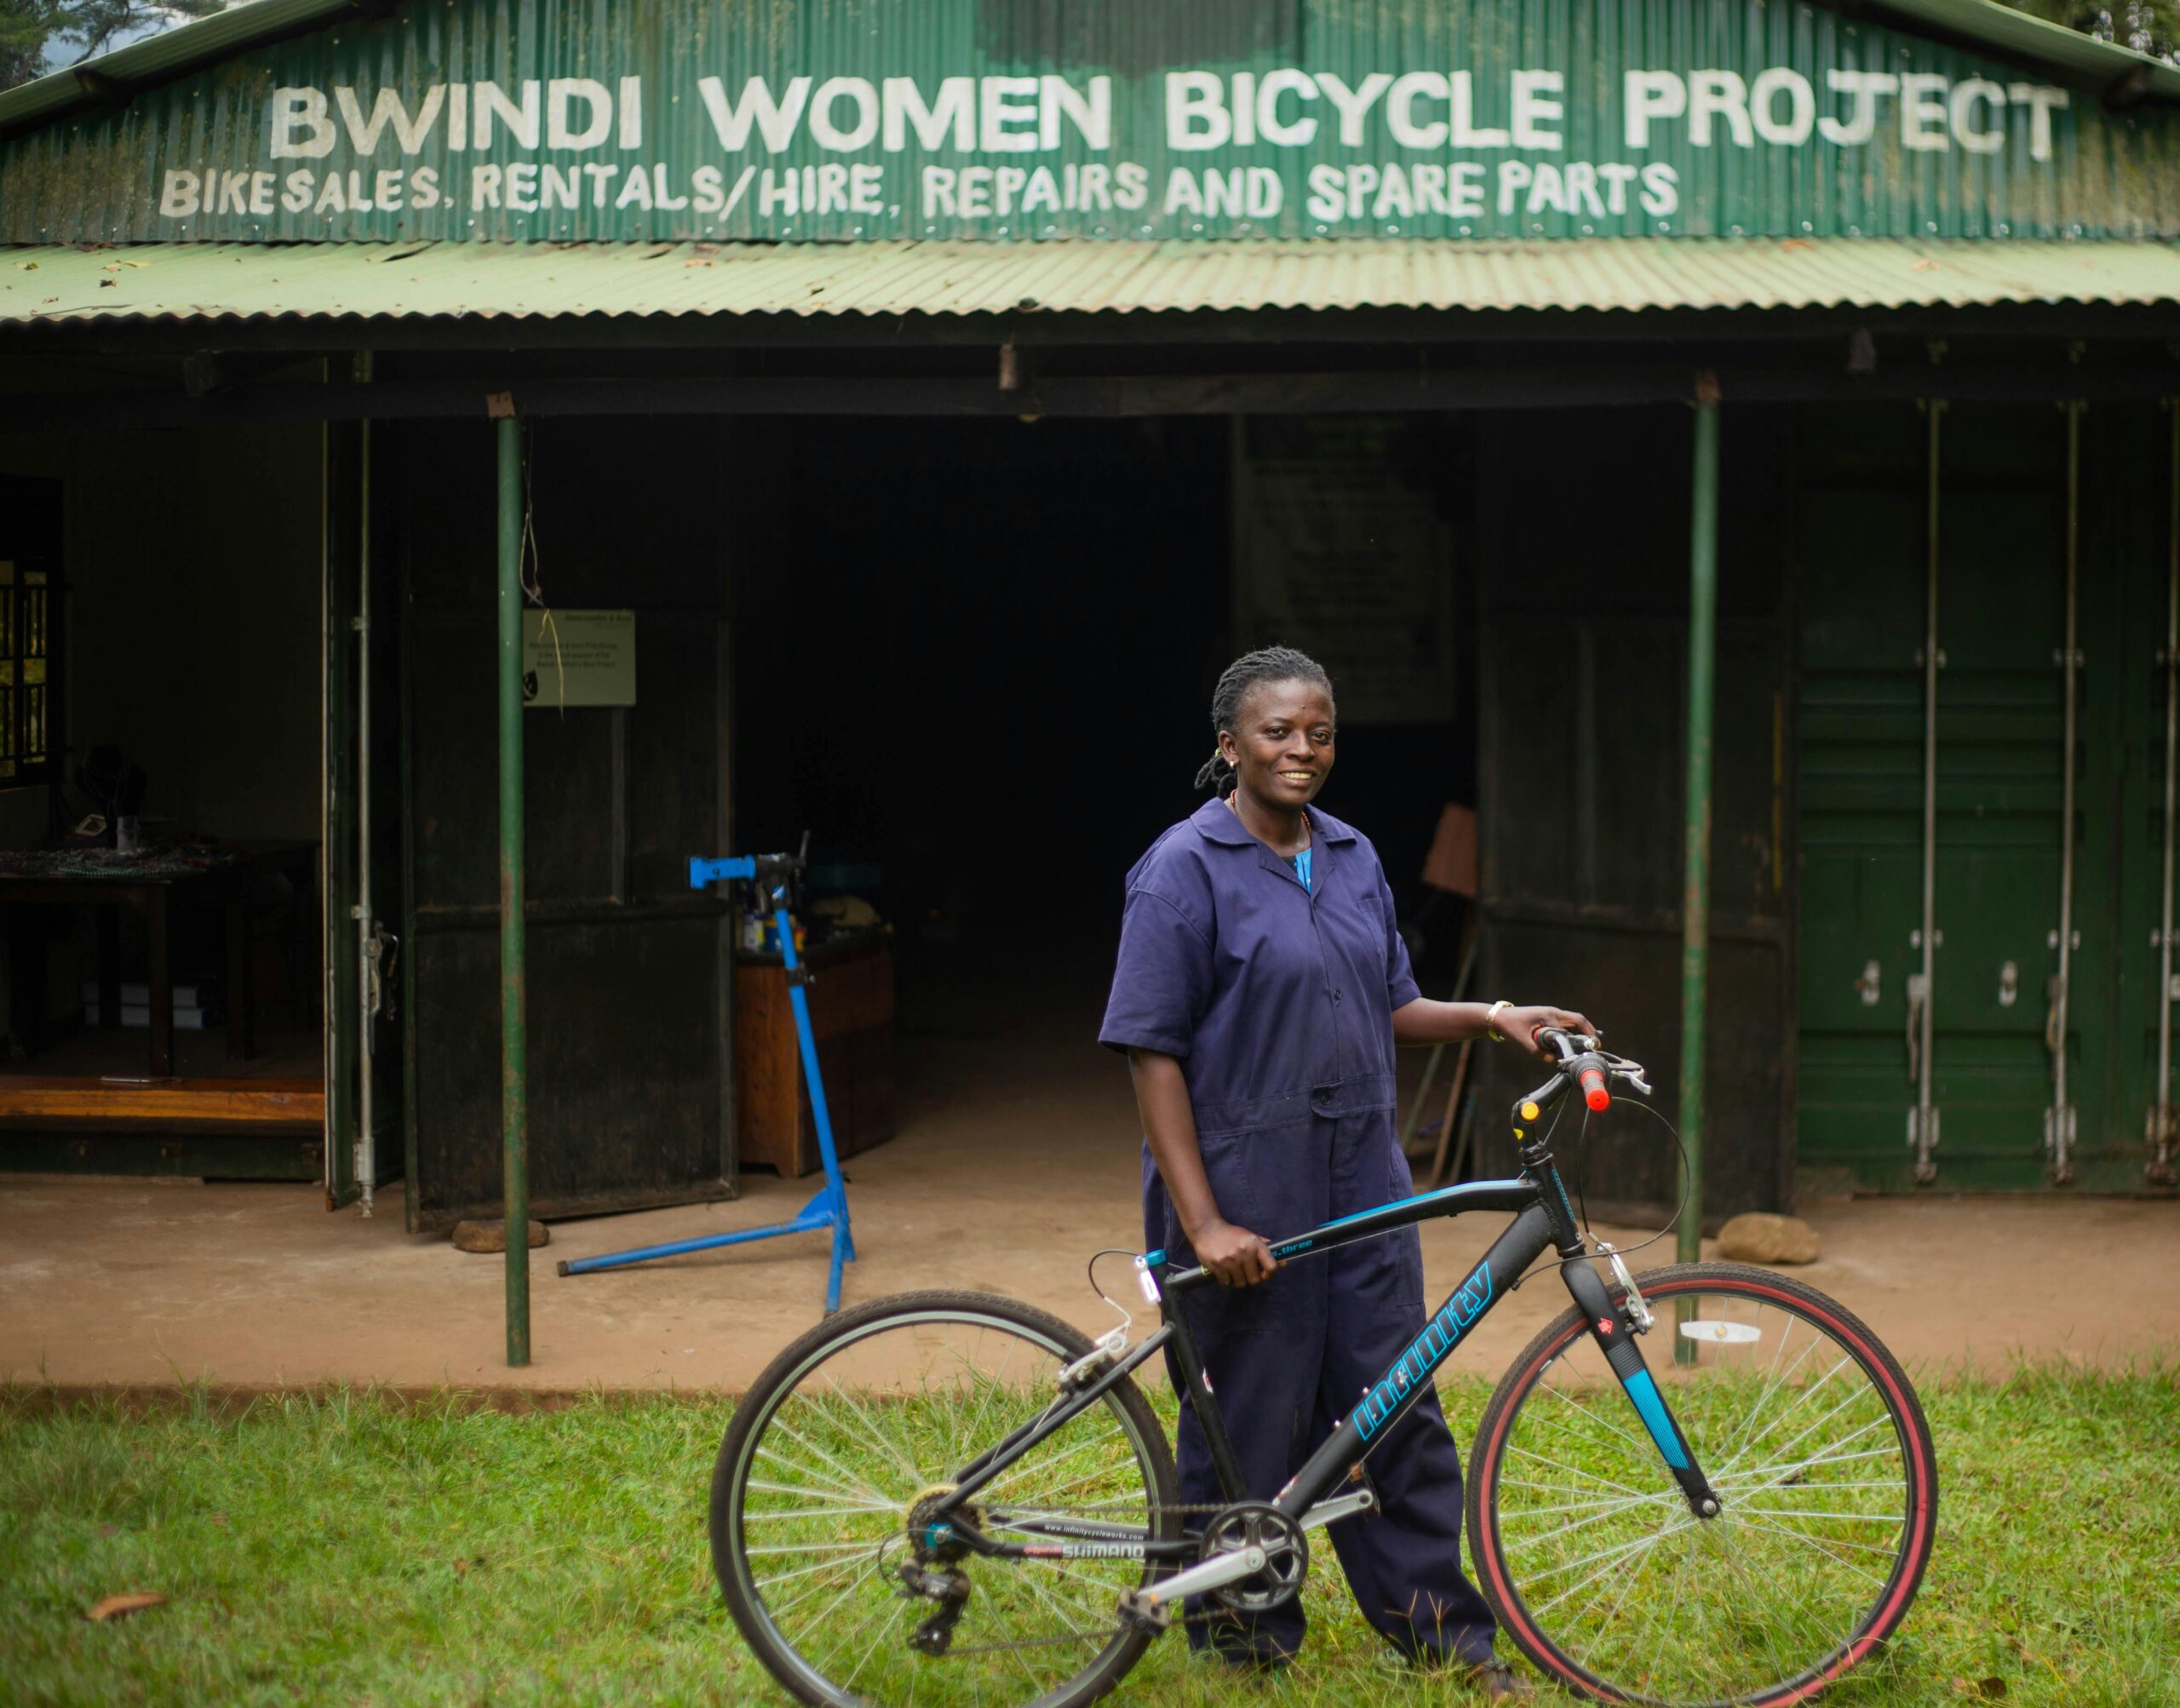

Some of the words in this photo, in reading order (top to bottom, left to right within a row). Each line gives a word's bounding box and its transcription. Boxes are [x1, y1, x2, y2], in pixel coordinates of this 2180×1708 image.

[270, 75, 642, 159] BWINDI
[697, 74, 1112, 154] WOMEN
[1165, 67, 1564, 152] BICYCLE
[1624, 66, 2069, 162] PROJECT
[921, 161, 1149, 221] REPAIRS
[1163, 166, 1283, 219] AND
[1306, 161, 1486, 223] SPARE
[1496, 159, 1679, 220] PARTS
